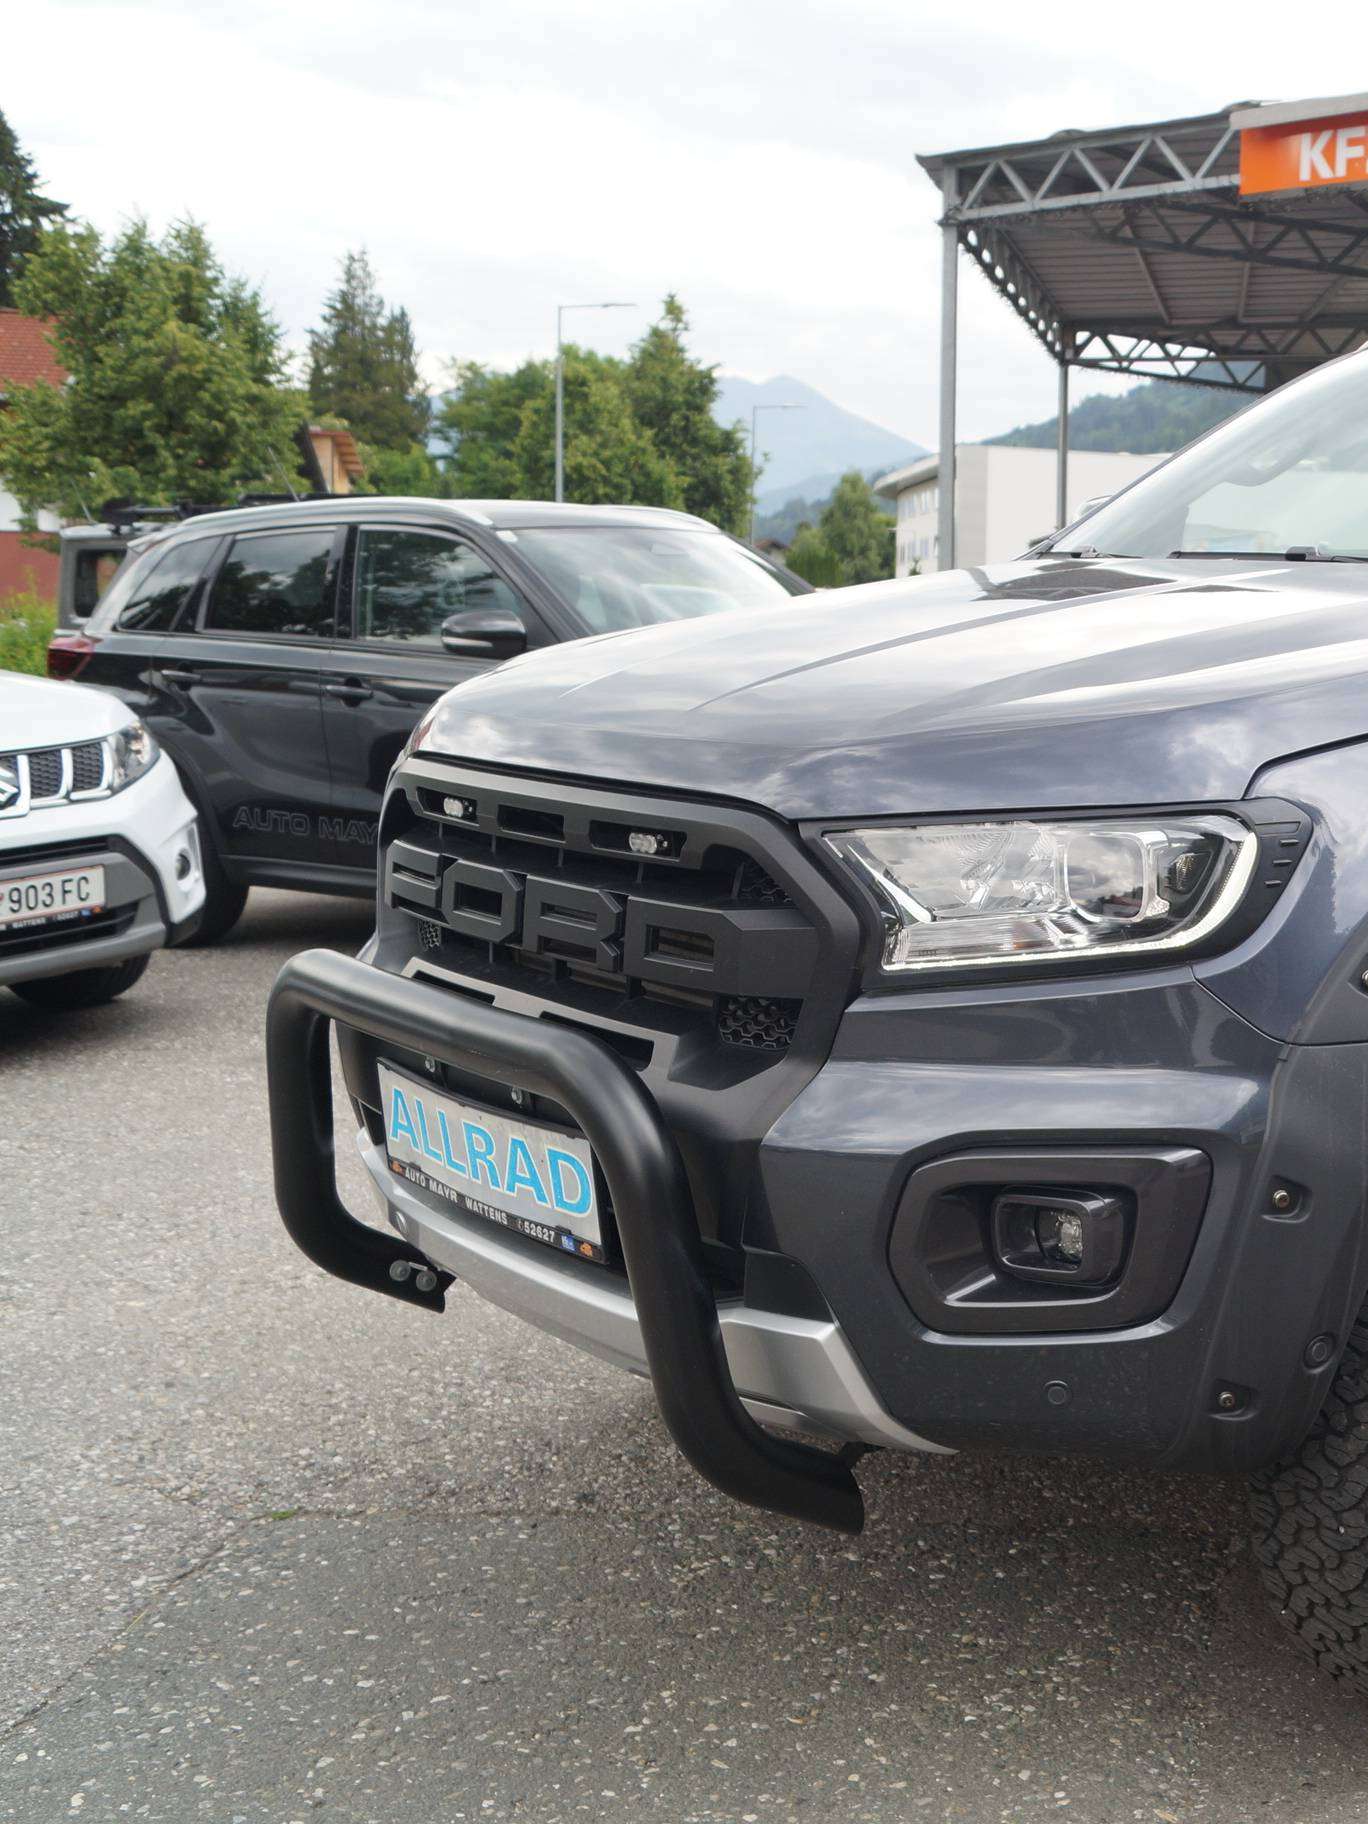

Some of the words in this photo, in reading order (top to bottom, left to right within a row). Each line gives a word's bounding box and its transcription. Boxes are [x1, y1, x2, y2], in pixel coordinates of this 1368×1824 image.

[233, 806, 310, 836] AUTO
[318, 815, 379, 845] MAY
[8, 882, 54, 913] 903
[61, 876, 90, 906] FC
[389, 1087, 594, 1218] ALLRAD
[405, 1167, 426, 1187] AUTO
[429, 1180, 458, 1203] MAYR
[465, 1197, 508, 1225] WATTENS
